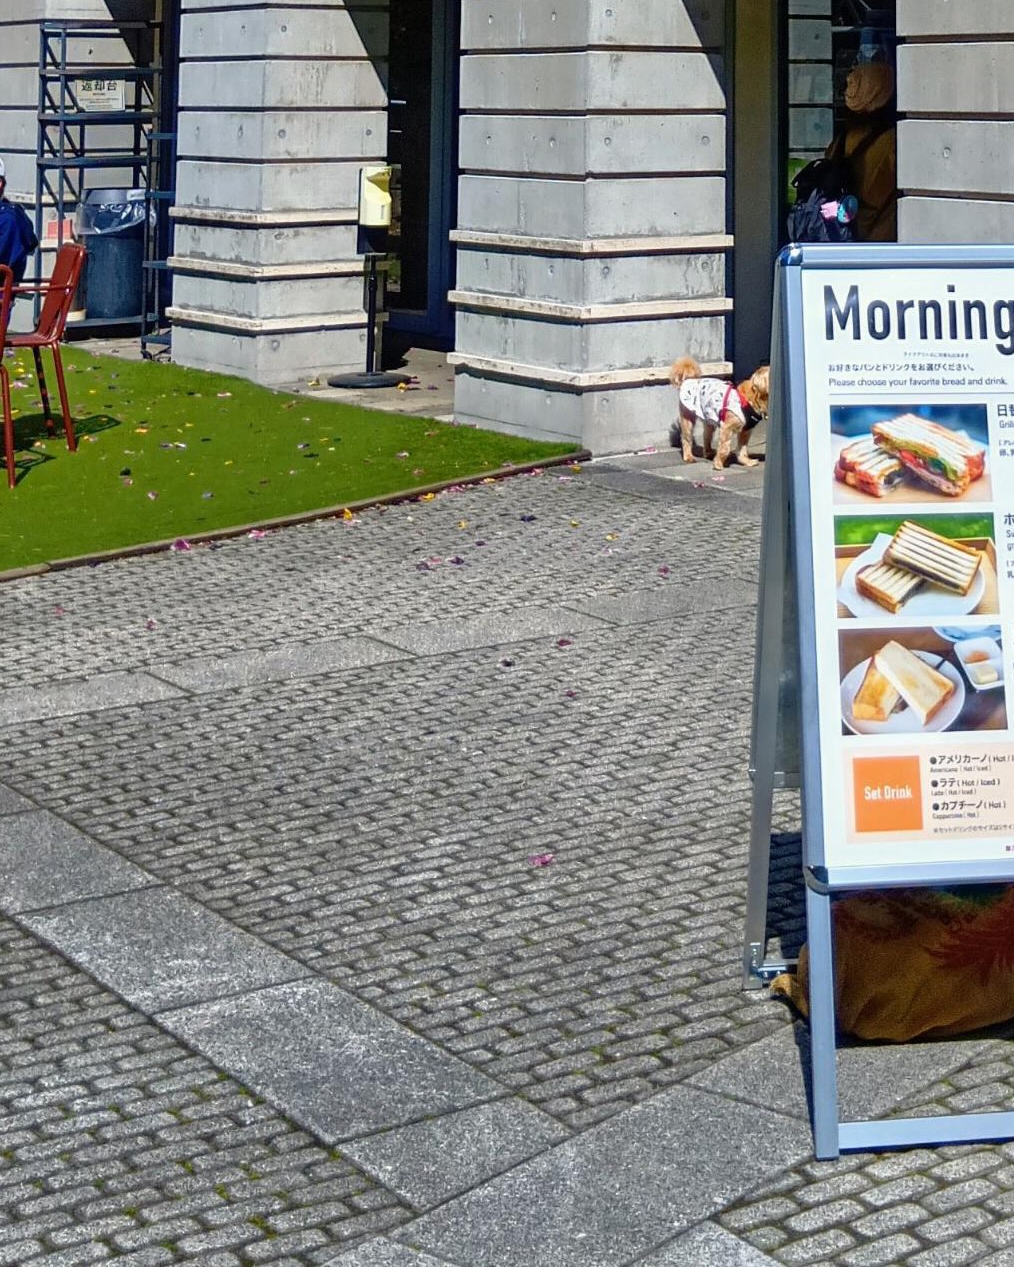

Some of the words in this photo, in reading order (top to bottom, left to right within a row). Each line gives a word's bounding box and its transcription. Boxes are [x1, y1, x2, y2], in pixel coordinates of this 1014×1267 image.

[828, 378, 856, 387] Please
[857, 378, 887, 387] choose
[888, 378, 907, 388] your
[909, 377, 940, 386] favorite
[942, 377, 966, 386] bread
[967, 377, 983, 386] and
[864, 786, 881, 800] Set
[883, 786, 912, 800] Drink
